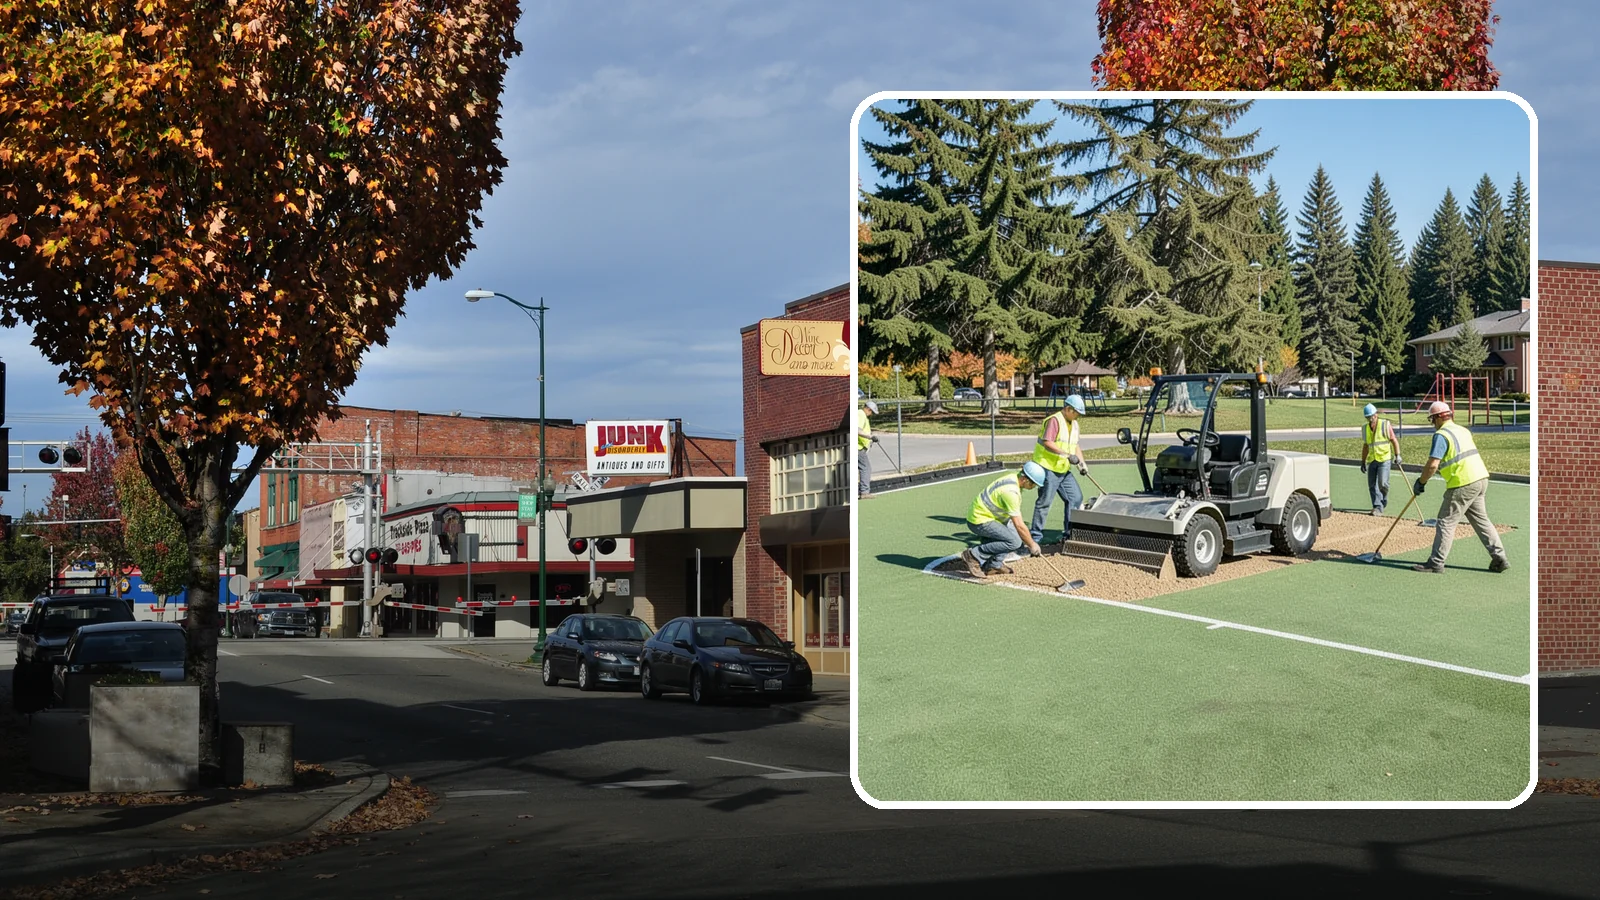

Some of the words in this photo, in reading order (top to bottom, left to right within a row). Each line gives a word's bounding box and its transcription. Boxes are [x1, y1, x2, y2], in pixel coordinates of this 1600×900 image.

[595, 425, 664, 457] JUNK
[607, 446, 645, 454] DISORDERLY
[597, 461, 628, 470] ANTIQUES
[631, 460, 644, 470] AND
[647, 460, 665, 470] GIFTS
[588, 475, 608, 492] SING
[414, 519, 429, 534] Pizza
